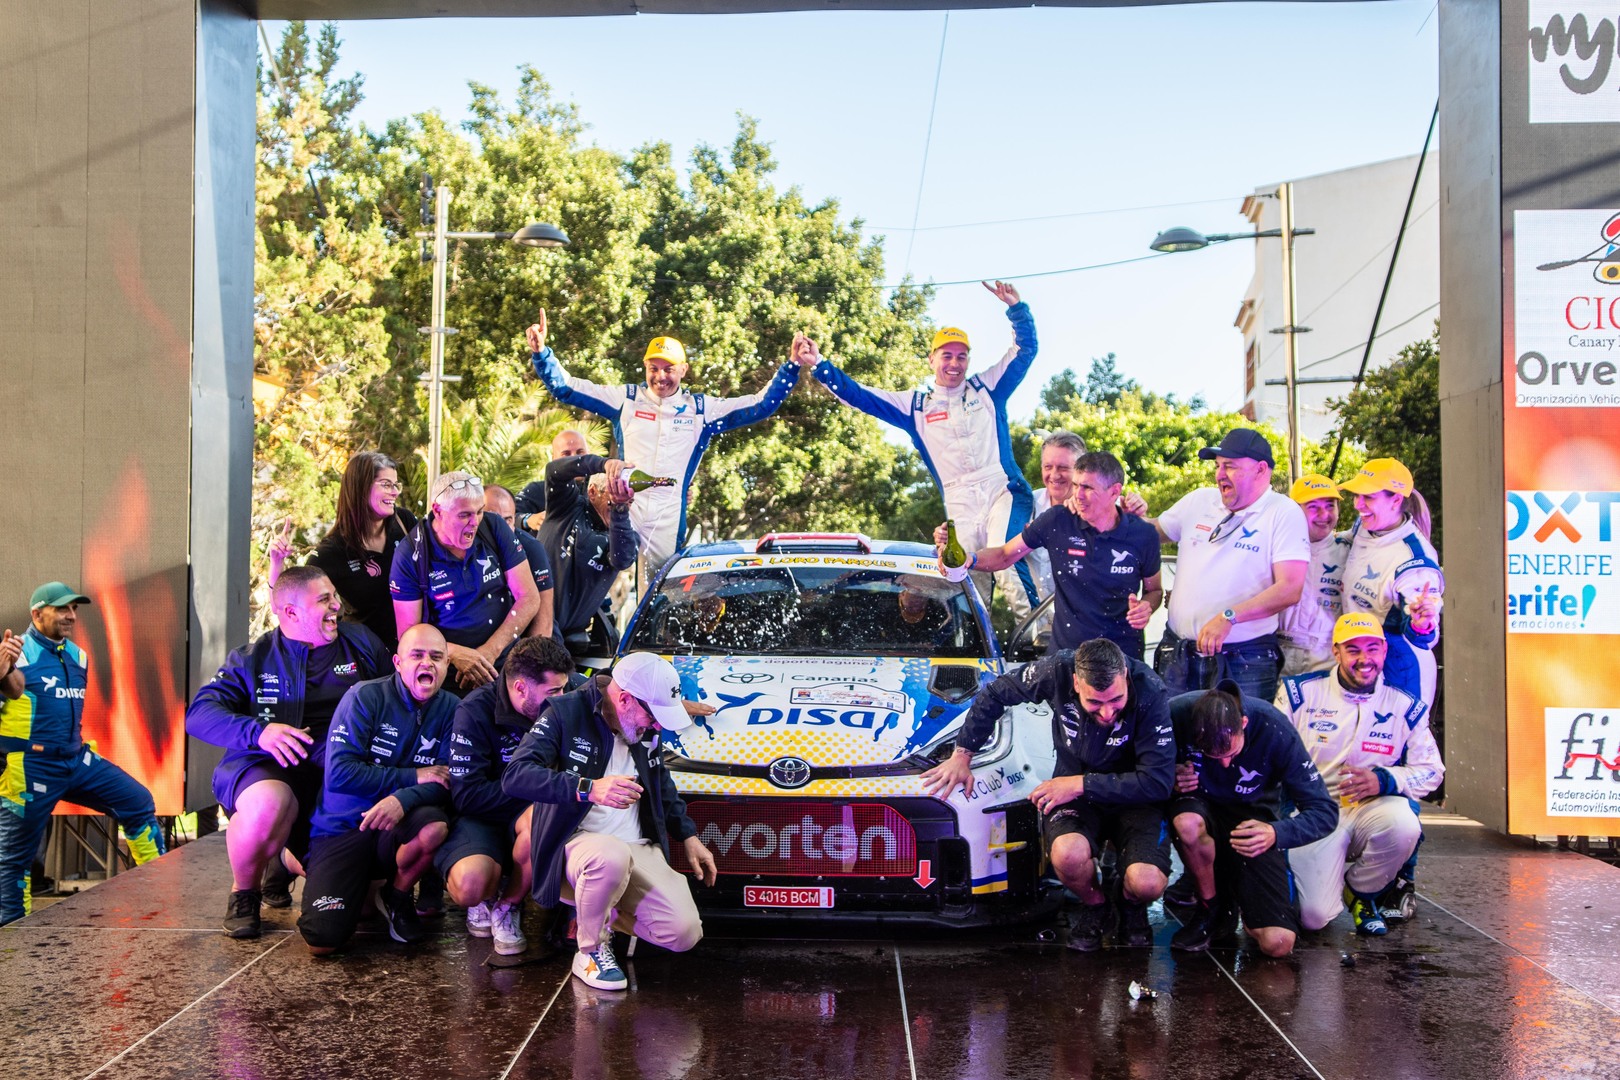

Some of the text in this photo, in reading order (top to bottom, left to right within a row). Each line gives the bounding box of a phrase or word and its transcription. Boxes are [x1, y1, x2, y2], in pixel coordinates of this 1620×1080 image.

[1568, 334, 1616, 350] Canary
[1515, 351, 1617, 386] Orve
[1517, 393, 1587, 407] Organización
[689, 561, 712, 569] NAPA
[769, 556, 898, 569] LORO PARQUE
[679, 574, 697, 592] 1
[1511, 618, 1577, 630] emociones
[791, 674, 879, 683] Canarias
[976, 774, 1002, 795] Club
[1552, 789, 1606, 800] Federación
[747, 890, 756, 902] S
[759, 890, 788, 903] 4015
[791, 891, 819, 904] BCM
